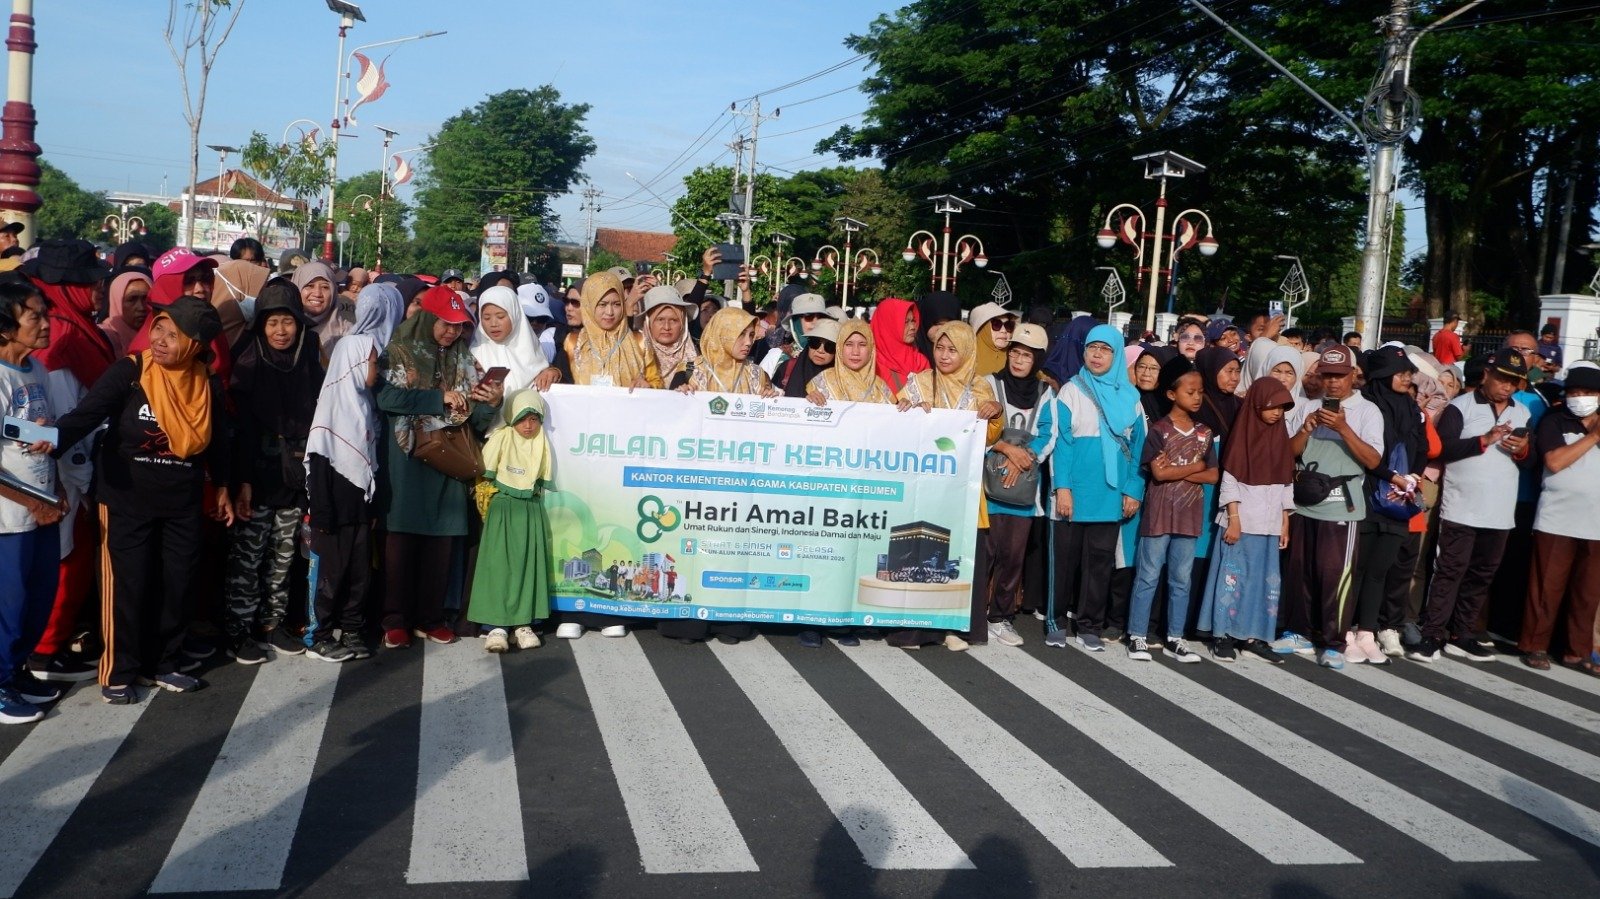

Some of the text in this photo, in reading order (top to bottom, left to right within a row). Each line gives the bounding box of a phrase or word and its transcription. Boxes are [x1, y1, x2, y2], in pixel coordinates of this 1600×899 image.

[767, 405, 796, 413] Kemenag
[569, 432, 957, 475] JALAN SEHAT KERUKUNAN
[631, 472, 897, 496] KANTOR KEMENTERIAN AGAMA KABUPATEN KEBUMEN
[685, 500, 738, 523] Hari
[745, 503, 814, 526] Amal
[822, 508, 888, 530] Bakti
[683, 523, 706, 532] Umat
[708, 525, 733, 533] Rukun
[735, 526, 750, 534] dan
[781, 528, 819, 537] Indonesia
[820, 530, 847, 539] Damai
[848, 532, 862, 540] dan
[863, 532, 881, 541] Maju
[743, 542, 772, 550] FINISH
[797, 545, 833, 553] SELASA
[589, 602, 669, 616] kemenag.kebumen.go.id
[715, 610, 775, 620] kemenagkebumen
[796, 613, 855, 624] kemenag kebumen
[876, 617, 933, 627] kemenagkebumen
